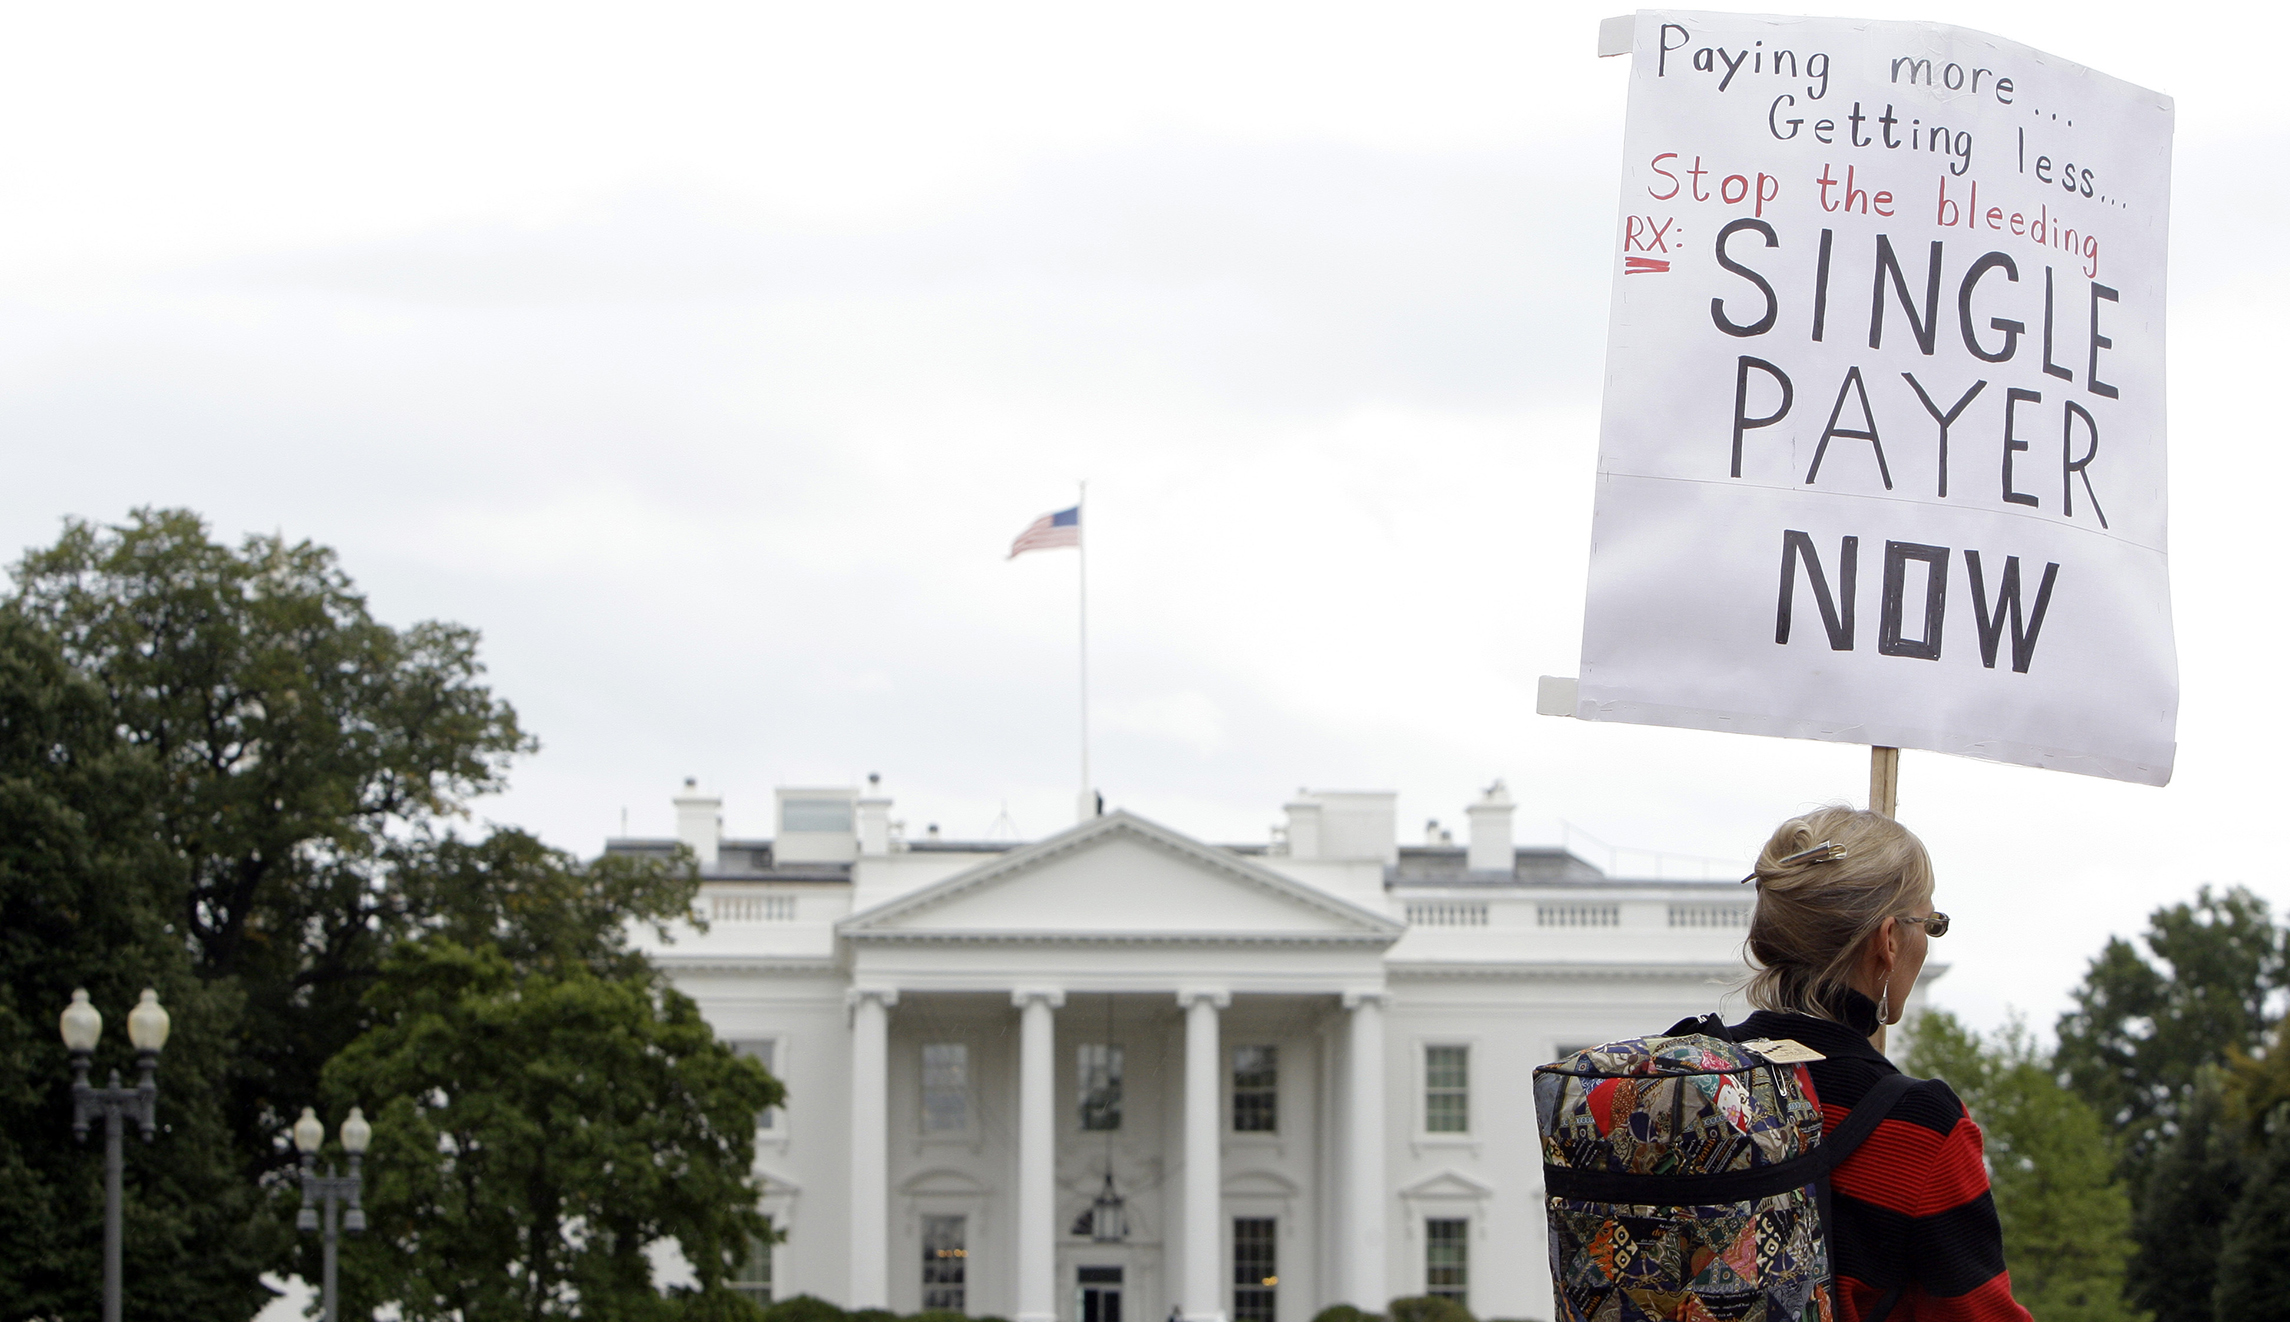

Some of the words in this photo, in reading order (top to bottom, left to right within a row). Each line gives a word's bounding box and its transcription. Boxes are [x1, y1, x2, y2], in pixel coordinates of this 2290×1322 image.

[1658, 23, 1830, 100] Paying
[1768, 94, 1972, 177] Getting
[1647, 152, 1779, 218] Stop
[1816, 163, 1895, 217] the
[1937, 175, 2098, 279] bleeding
[1710, 217, 2120, 401] SINGLE
[1730, 354, 2109, 530] PAYER
[1774, 528, 2061, 675] NOW
